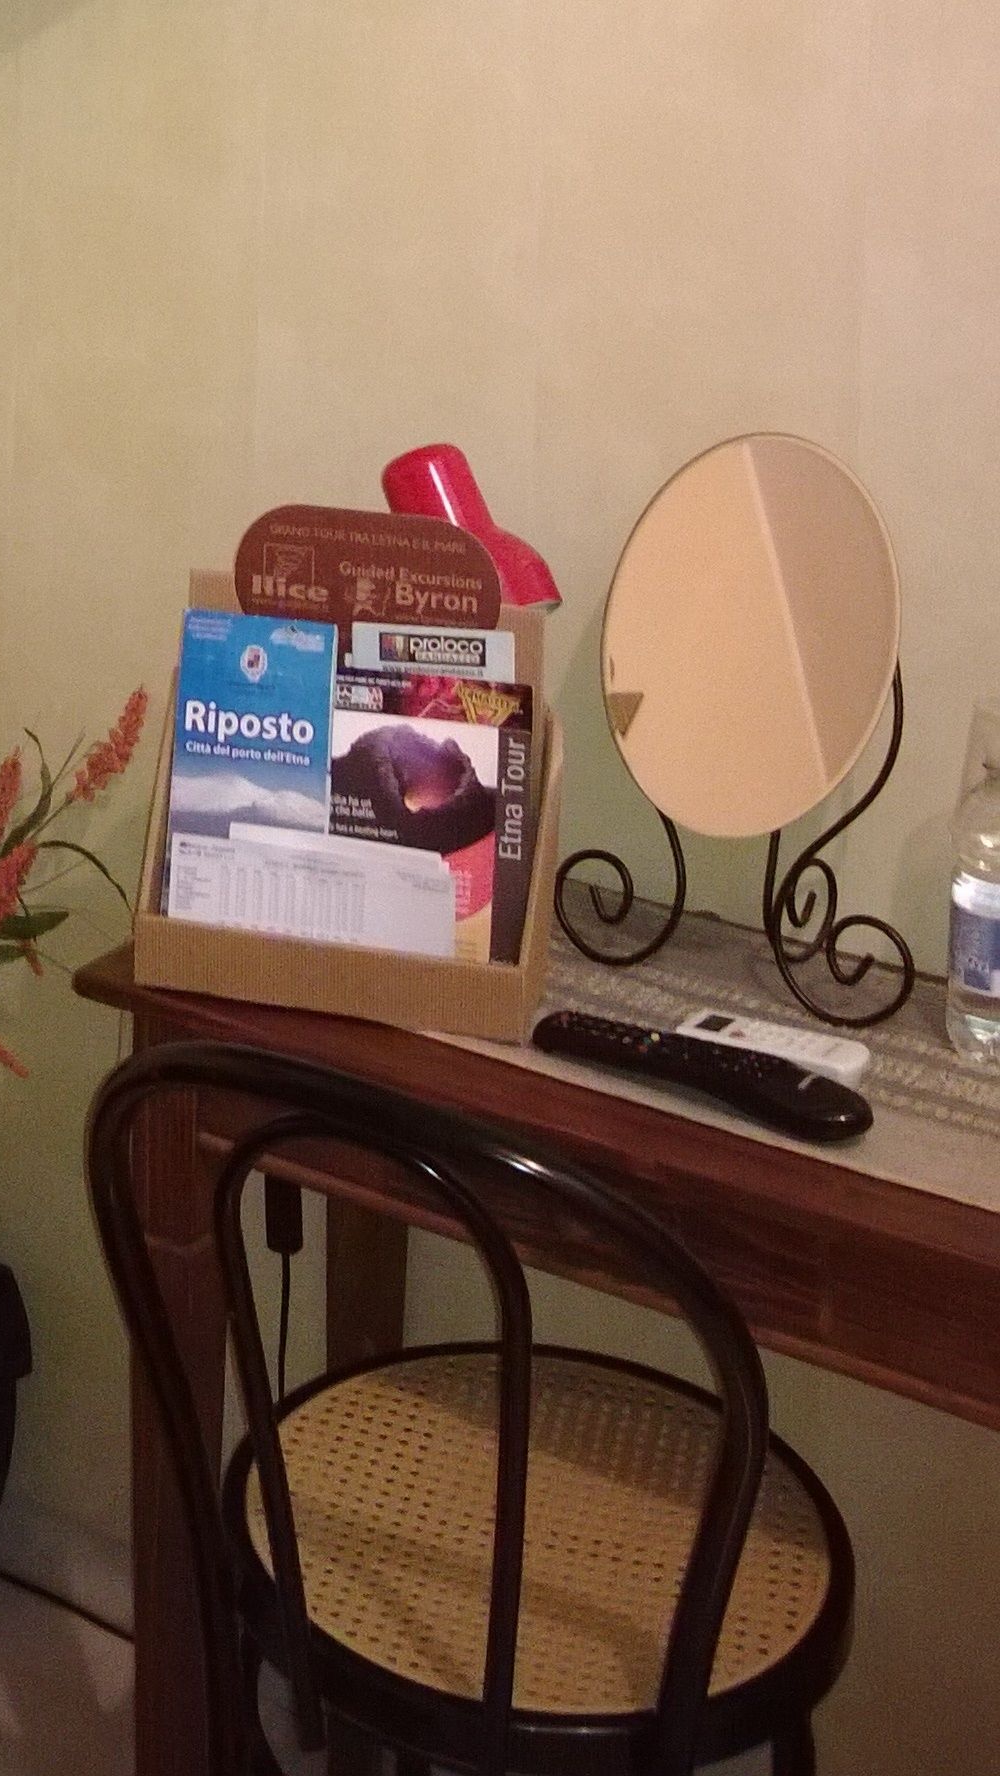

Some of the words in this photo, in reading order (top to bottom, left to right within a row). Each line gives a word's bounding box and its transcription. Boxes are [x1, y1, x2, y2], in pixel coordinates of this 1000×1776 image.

[314, 526, 346, 541] TOUR
[338, 560, 395, 581] Guided
[399, 567, 483, 591] Excursions
[395, 580, 479, 615] Byron
[409, 635, 484, 655] proloco
[184, 699, 315, 744] Riposto
[213, 742, 231, 757] del
[232, 745, 262, 761] porto
[501, 736, 526, 798] Tour
[499, 803, 524, 861] Etna
